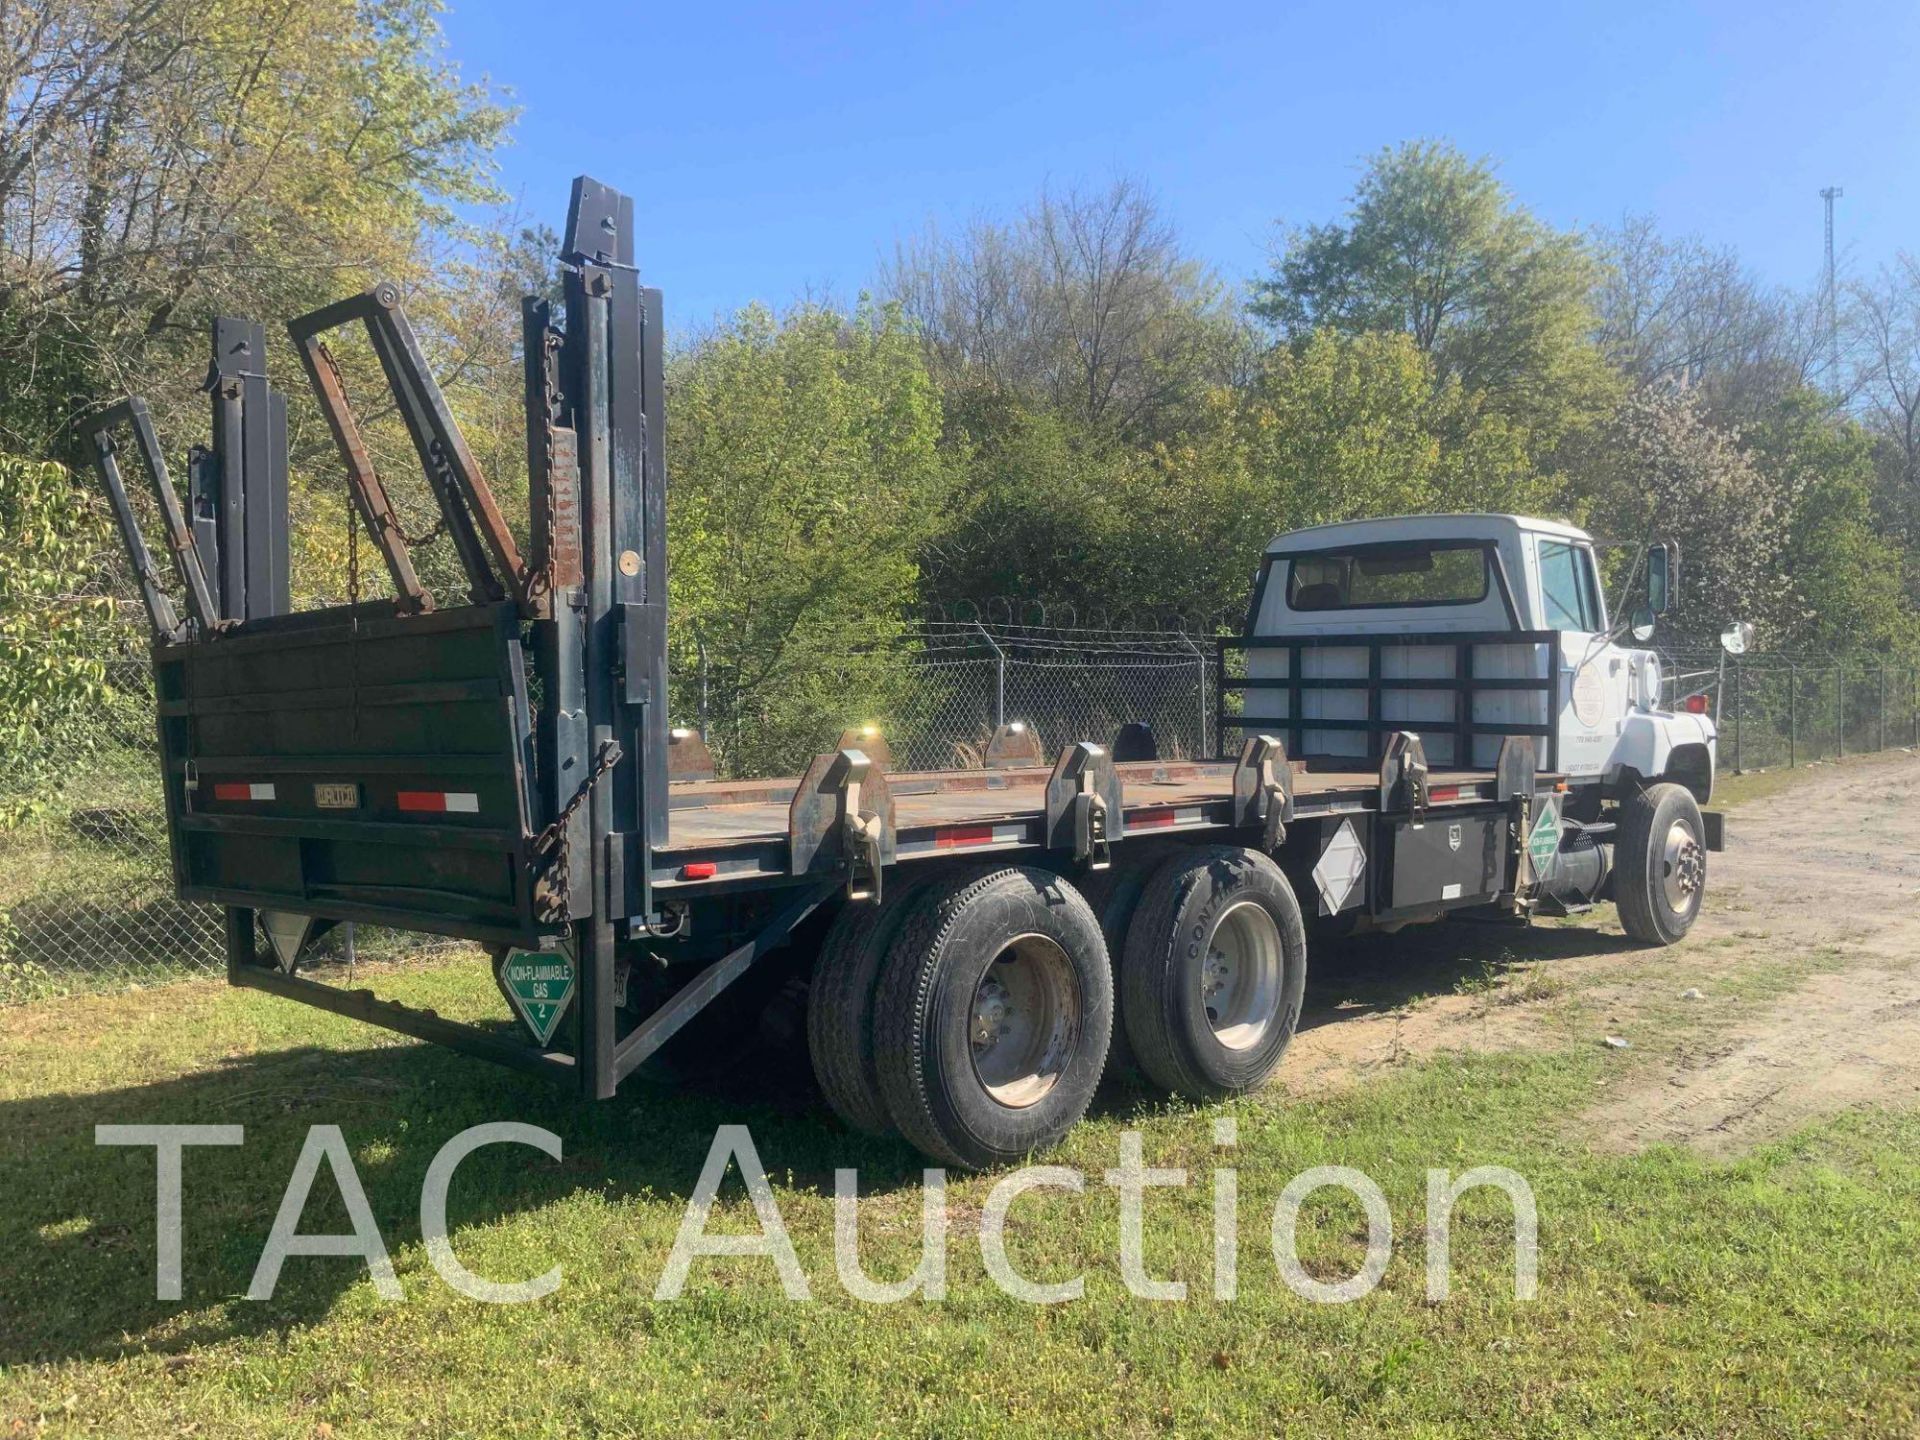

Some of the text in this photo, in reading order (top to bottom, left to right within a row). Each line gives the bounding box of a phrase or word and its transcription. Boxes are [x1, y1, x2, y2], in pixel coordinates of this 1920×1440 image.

[510, 964, 570, 981] NON-FLAMMABLE
[532, 982, 549, 998] GAS
[537, 1003, 546, 1018] 2
